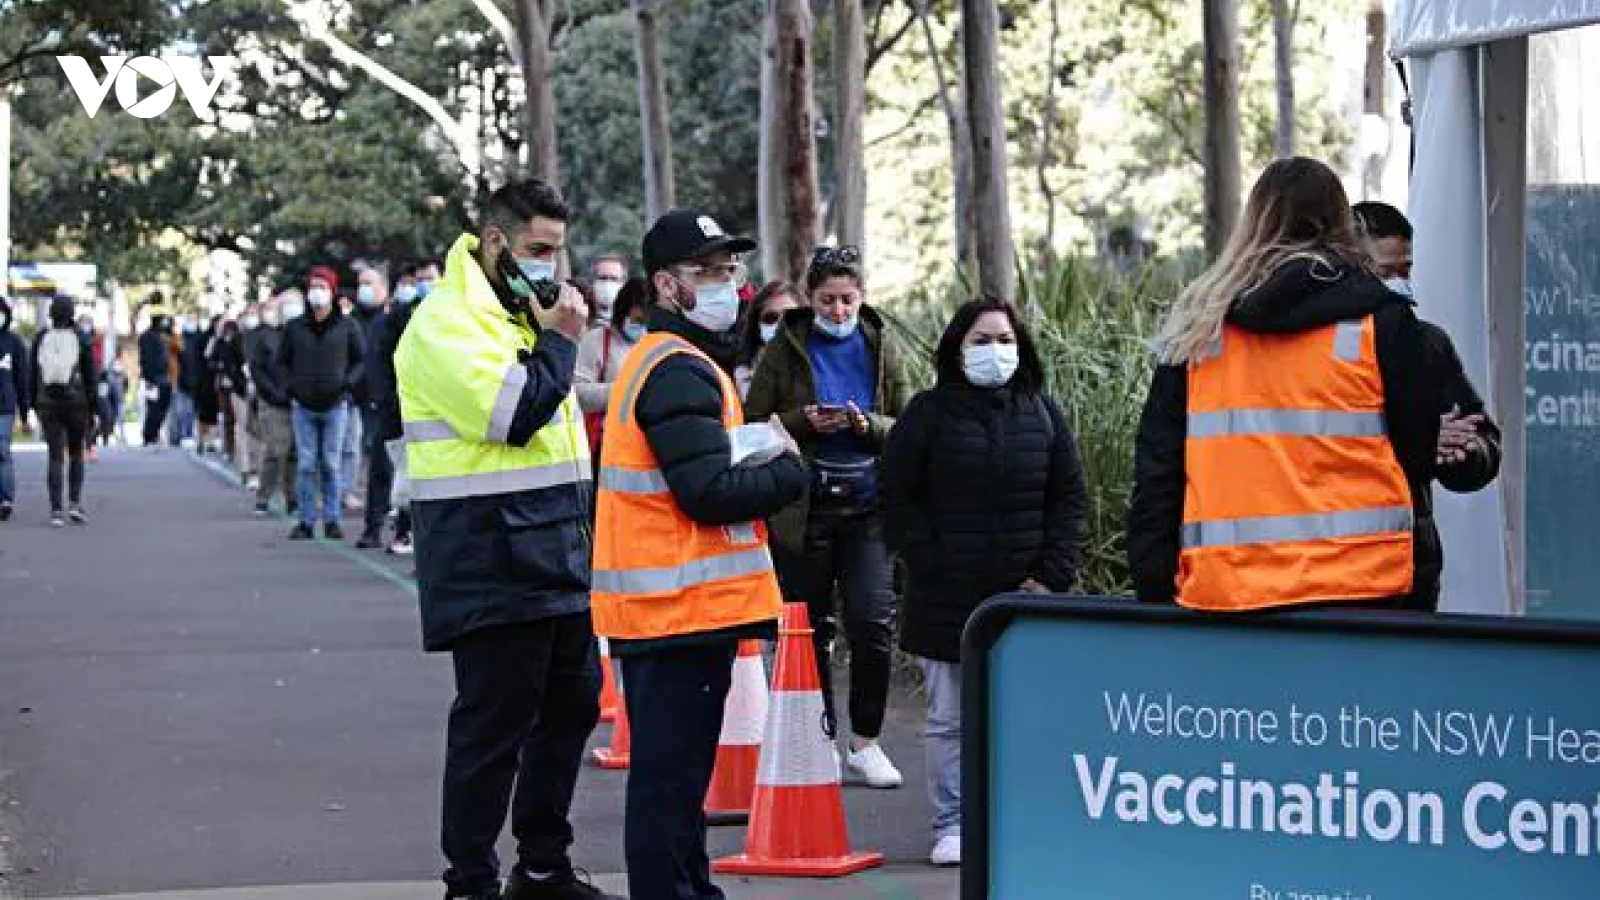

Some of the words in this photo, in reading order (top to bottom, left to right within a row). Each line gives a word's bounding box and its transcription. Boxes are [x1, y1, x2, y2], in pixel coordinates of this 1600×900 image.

[1104, 690, 1279, 743] Welcome
[1289, 703, 1327, 746] to
[1338, 705, 1401, 751] the
[1412, 710, 1514, 758] NSW
[1526, 717, 1600, 763] Hea
[1073, 754, 1444, 845] Vaccination
